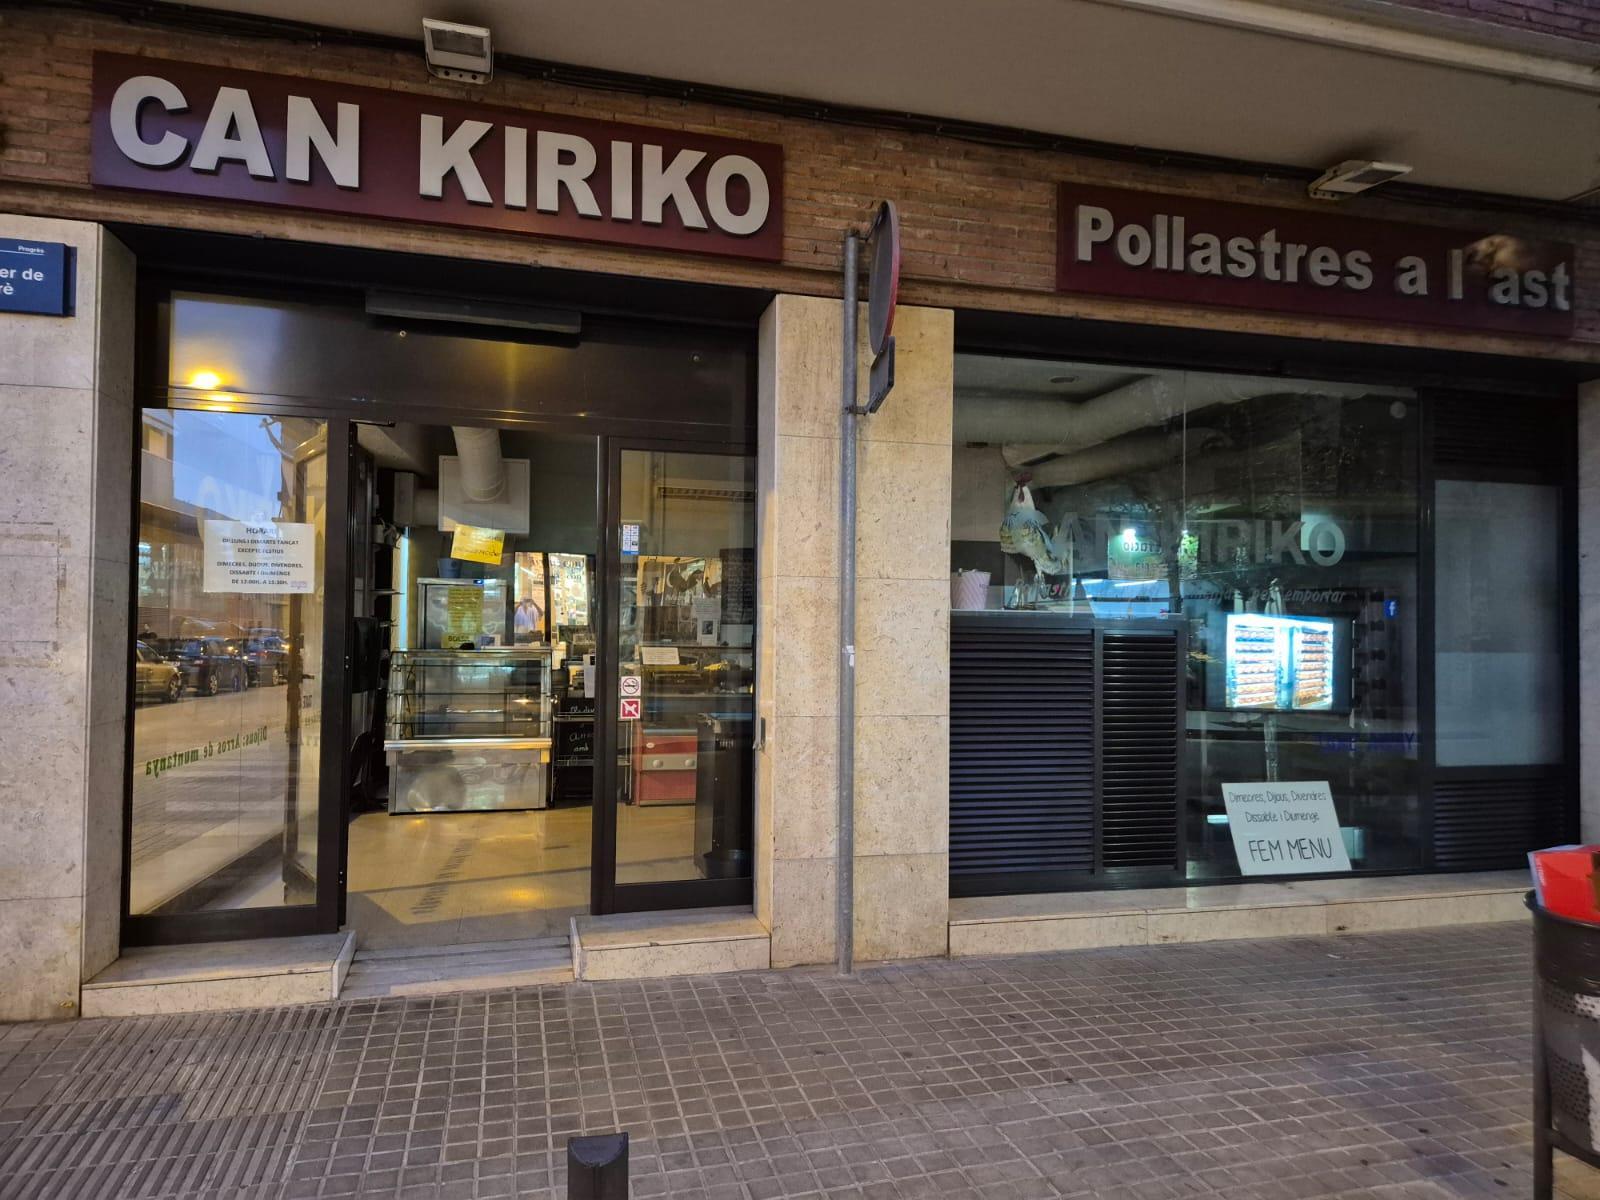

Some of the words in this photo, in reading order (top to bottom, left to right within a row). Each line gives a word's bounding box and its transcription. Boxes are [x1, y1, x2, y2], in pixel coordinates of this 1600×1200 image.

[109, 75, 359, 190] CAN
[419, 113, 770, 236] KIRIKO
[22, 268, 44, 281] de
[1075, 204, 1373, 291] Pollastres
[1398, 255, 1428, 296] a
[1248, 839, 1284, 862] FEM
[1286, 837, 1332, 861] MENU
